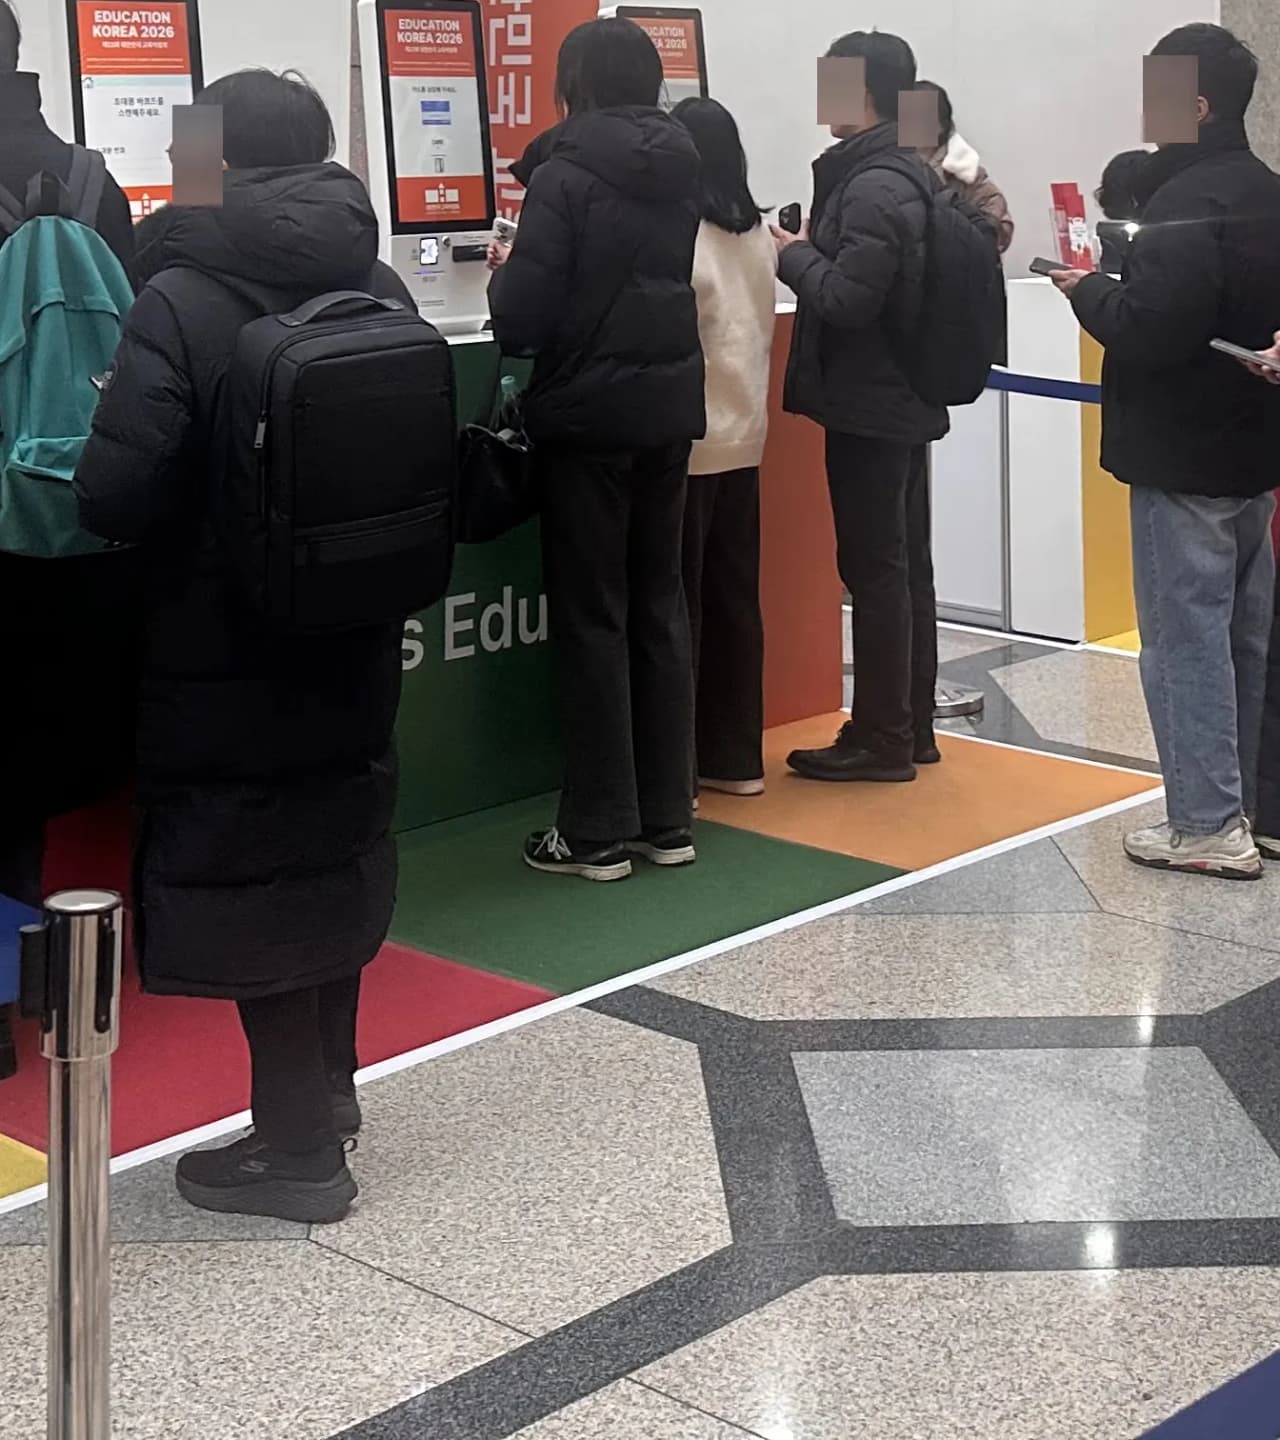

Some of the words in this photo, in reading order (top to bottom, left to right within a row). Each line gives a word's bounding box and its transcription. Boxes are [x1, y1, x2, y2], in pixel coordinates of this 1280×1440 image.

[94, 9, 171, 24] EDUCATION
[92, 24, 139, 38] KOREA
[140, 25, 175, 39] 2026
[398, 18, 460, 32] EDUCATION
[397, 31, 434, 44] KOREA
[435, 32, 463, 45] 2026
